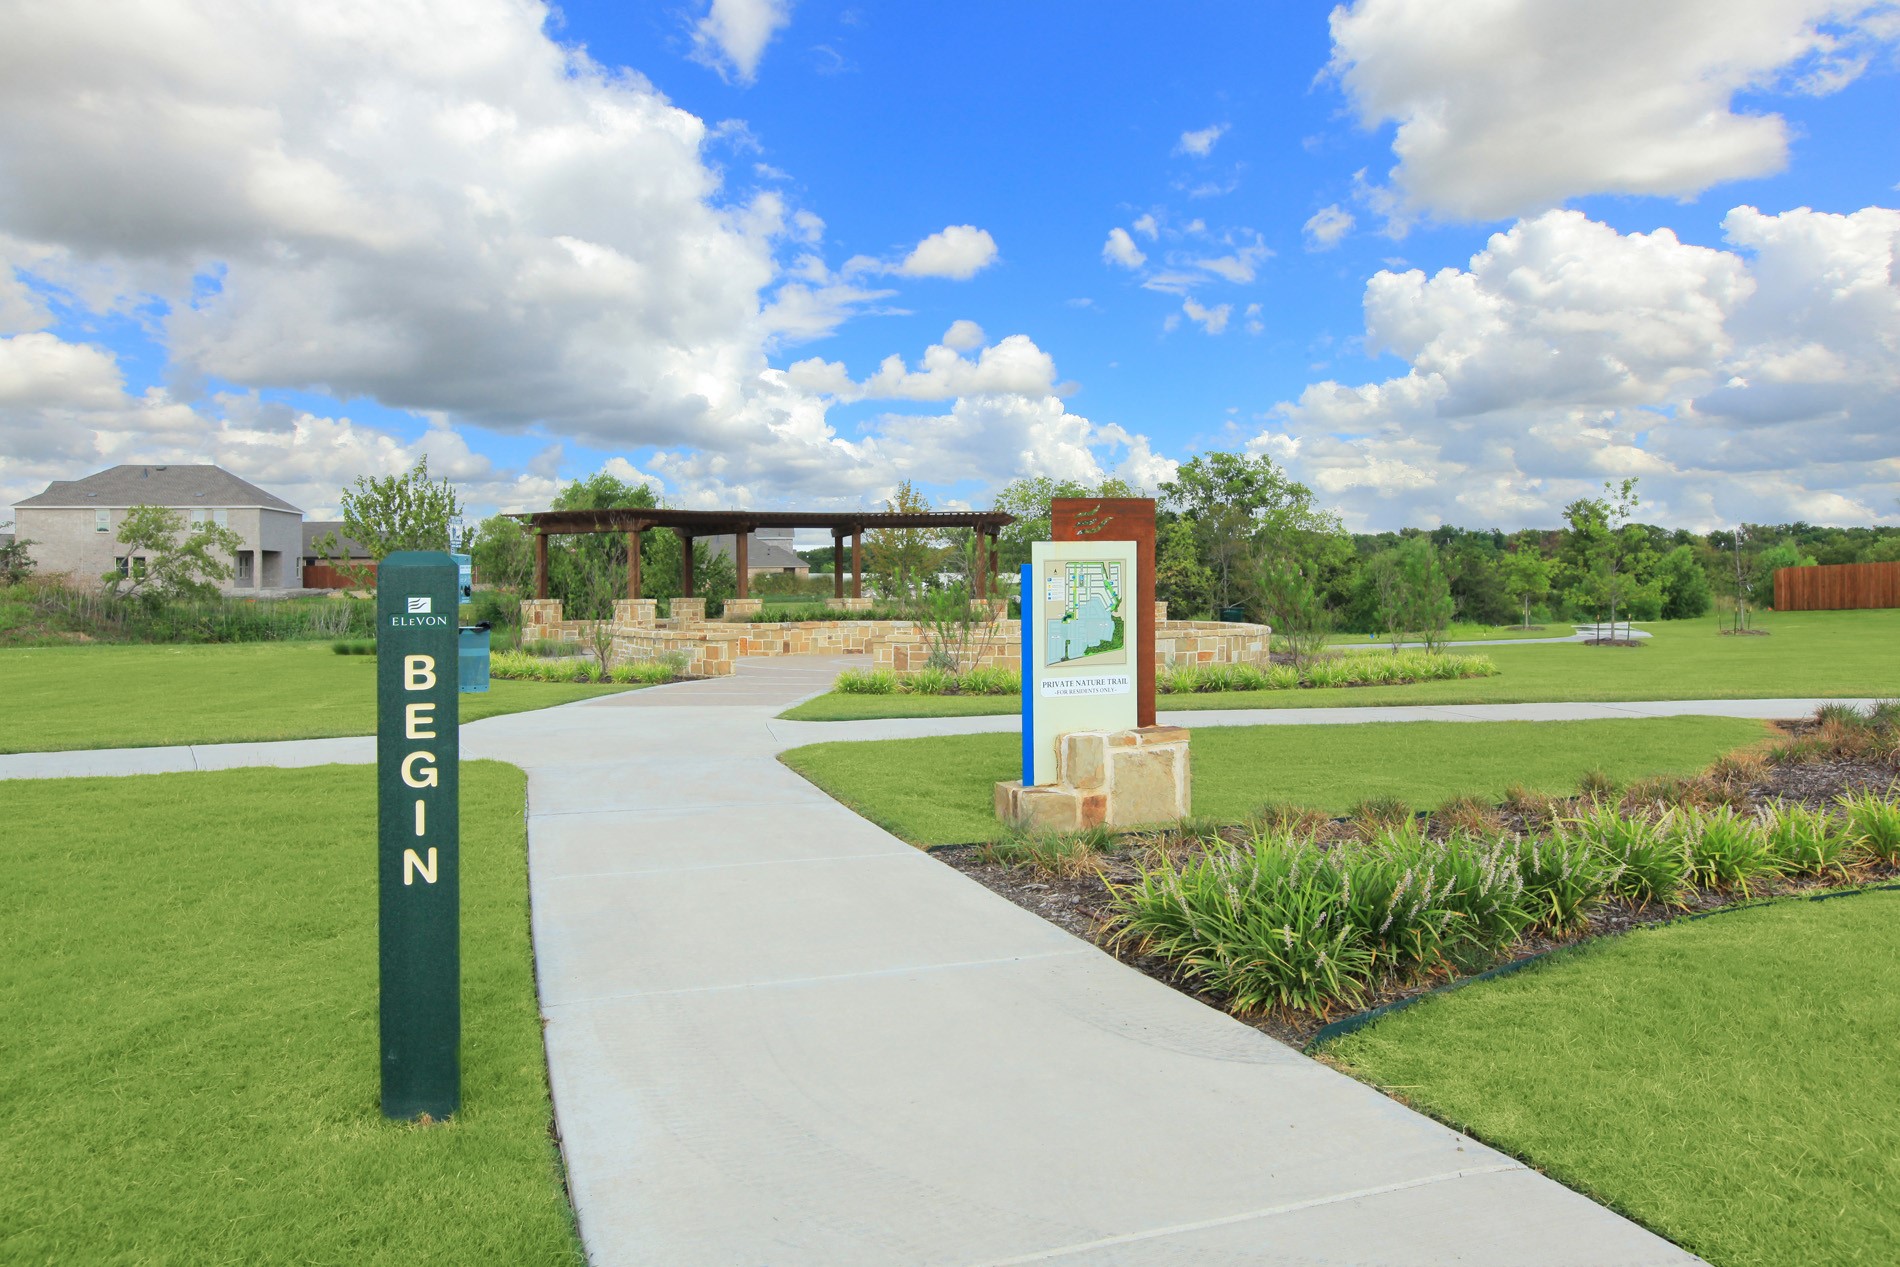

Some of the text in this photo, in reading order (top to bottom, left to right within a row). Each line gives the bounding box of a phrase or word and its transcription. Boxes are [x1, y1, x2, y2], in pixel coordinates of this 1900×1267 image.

[1042, 677, 1129, 689] PRIVATE NATURE TRAIL
[401, 654, 438, 886] BEGIN
